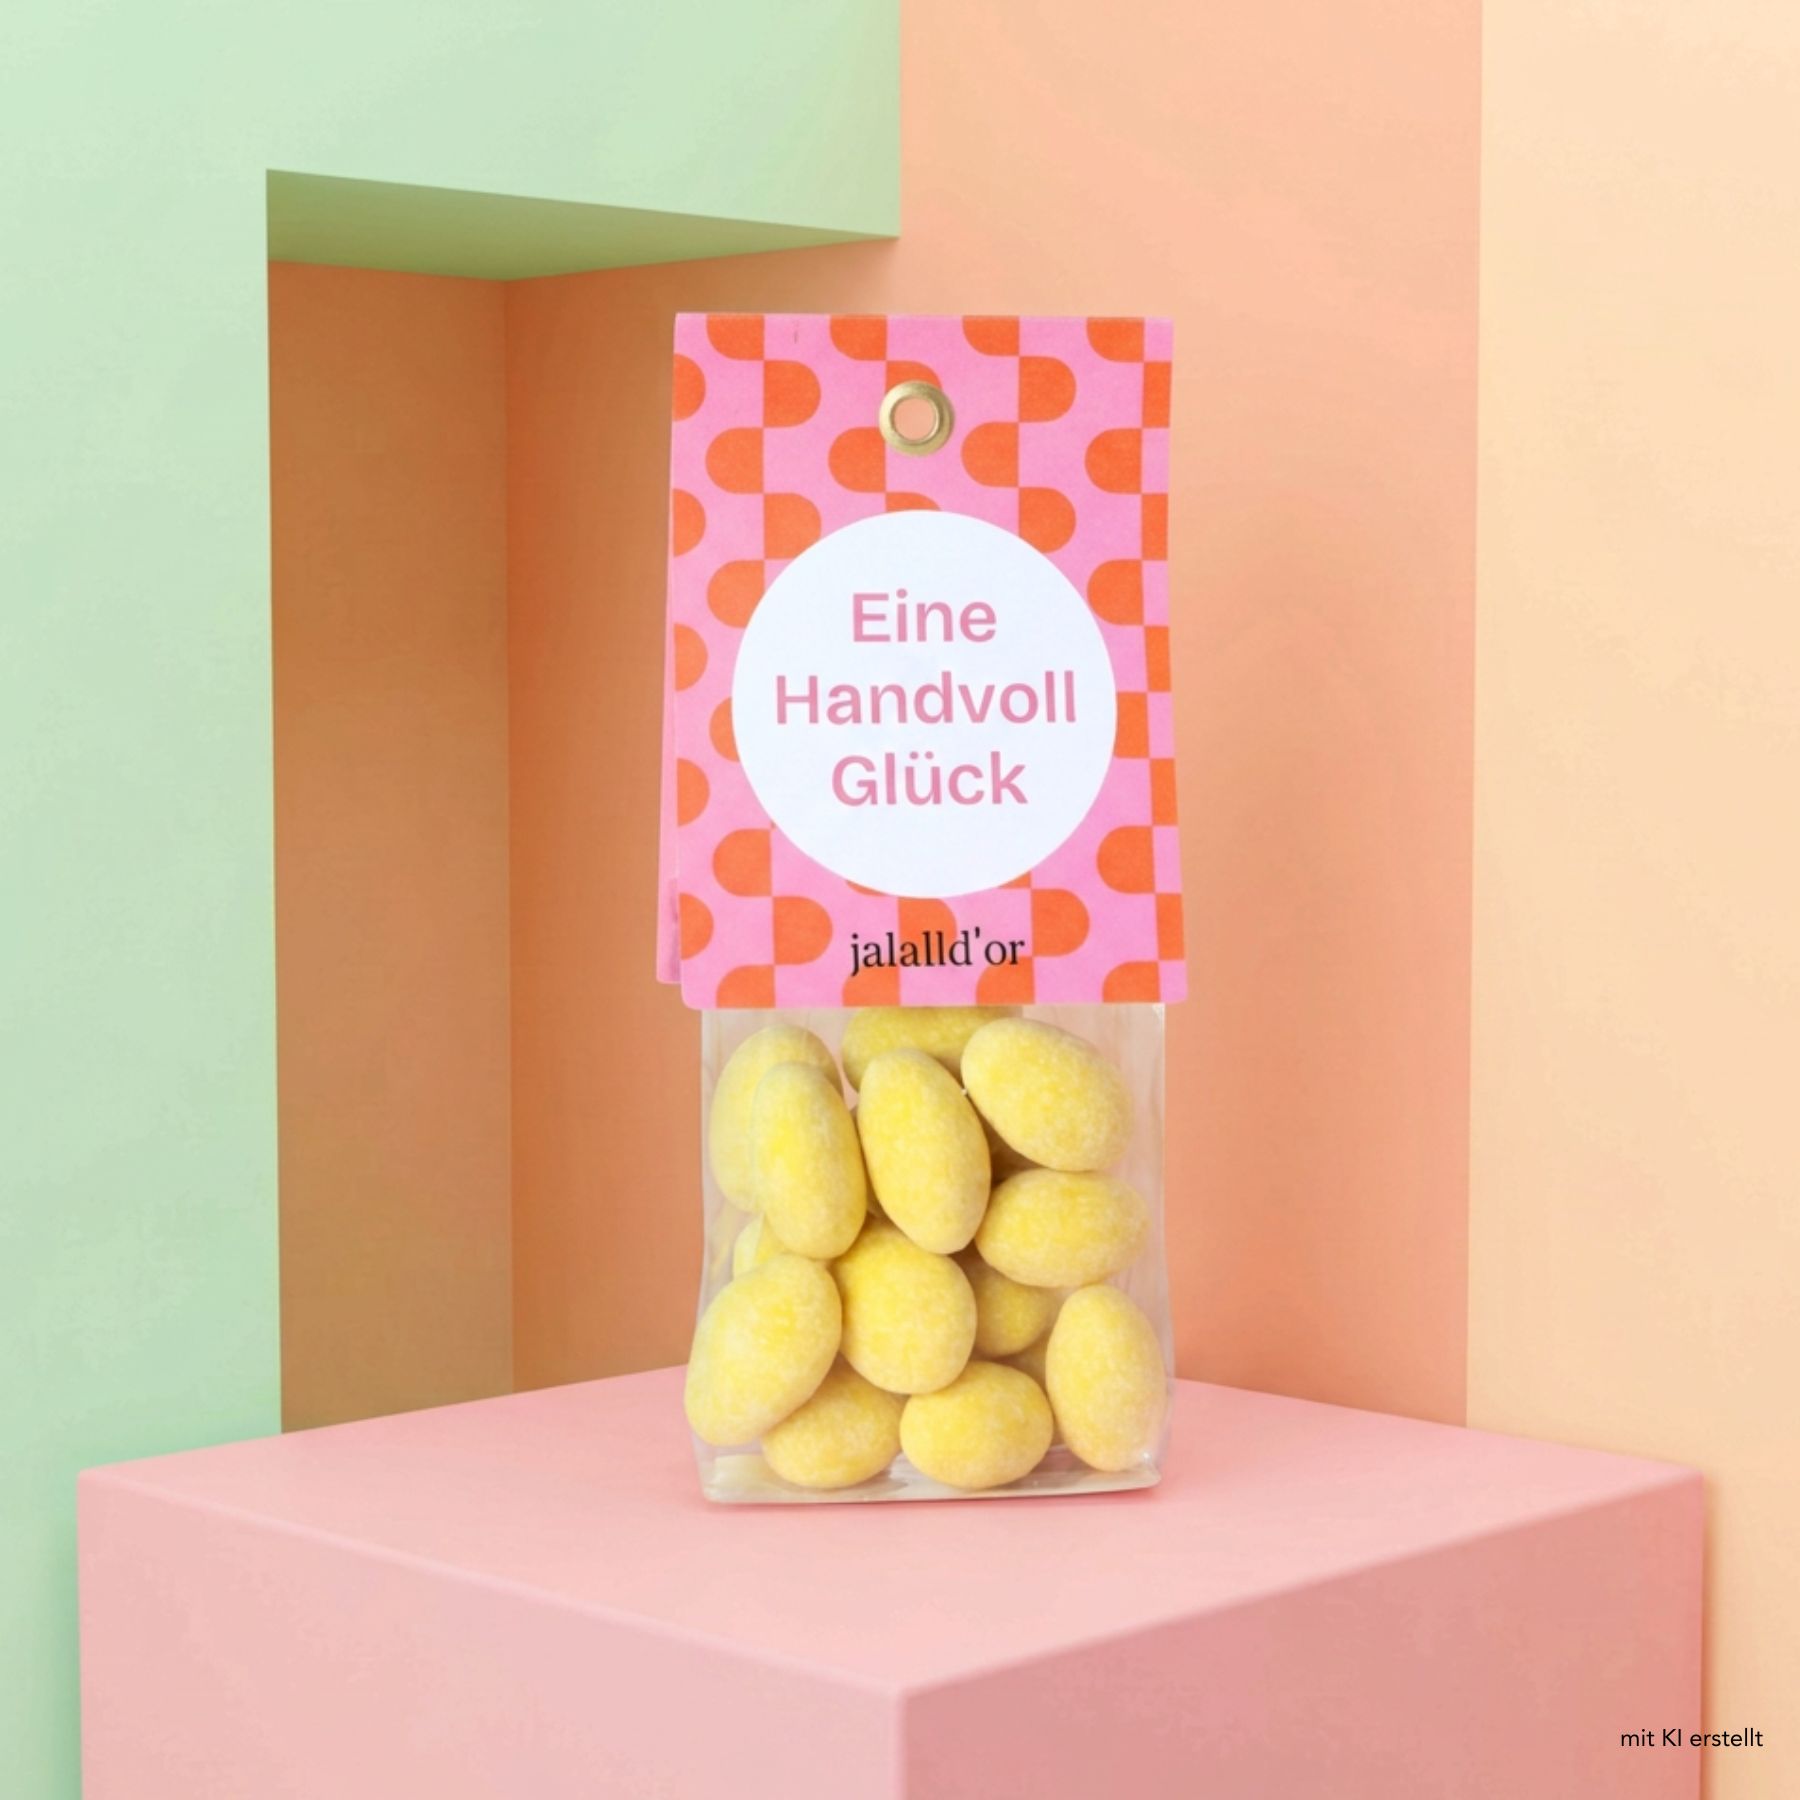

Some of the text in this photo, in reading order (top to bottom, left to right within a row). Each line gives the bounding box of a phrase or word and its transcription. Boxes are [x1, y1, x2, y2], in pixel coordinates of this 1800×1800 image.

[851, 589, 997, 643] Eine
[776, 670, 1077, 726] Handvoll
[831, 752, 1028, 807] Glück
[848, 927, 1025, 977] jalalld'or
